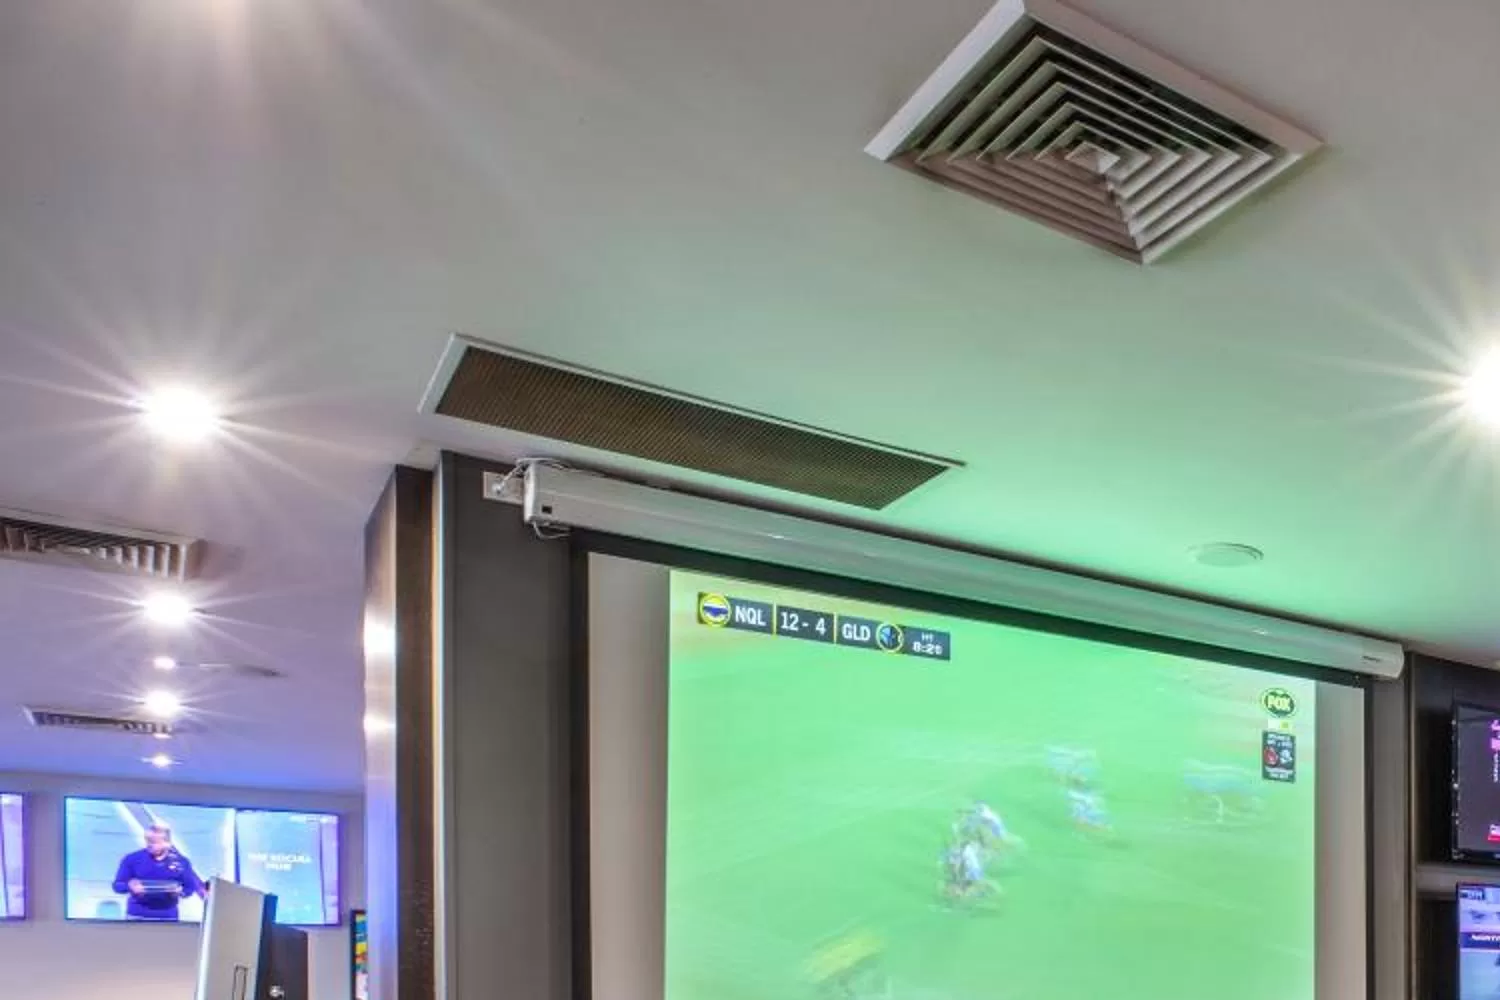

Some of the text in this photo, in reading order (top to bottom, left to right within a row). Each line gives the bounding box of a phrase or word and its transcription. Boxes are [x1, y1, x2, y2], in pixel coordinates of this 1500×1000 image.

[735, 605, 767, 626] NQL
[780, 612, 799, 632] 12
[815, 620, 826, 635] 4
[842, 623, 871, 642] GLD
